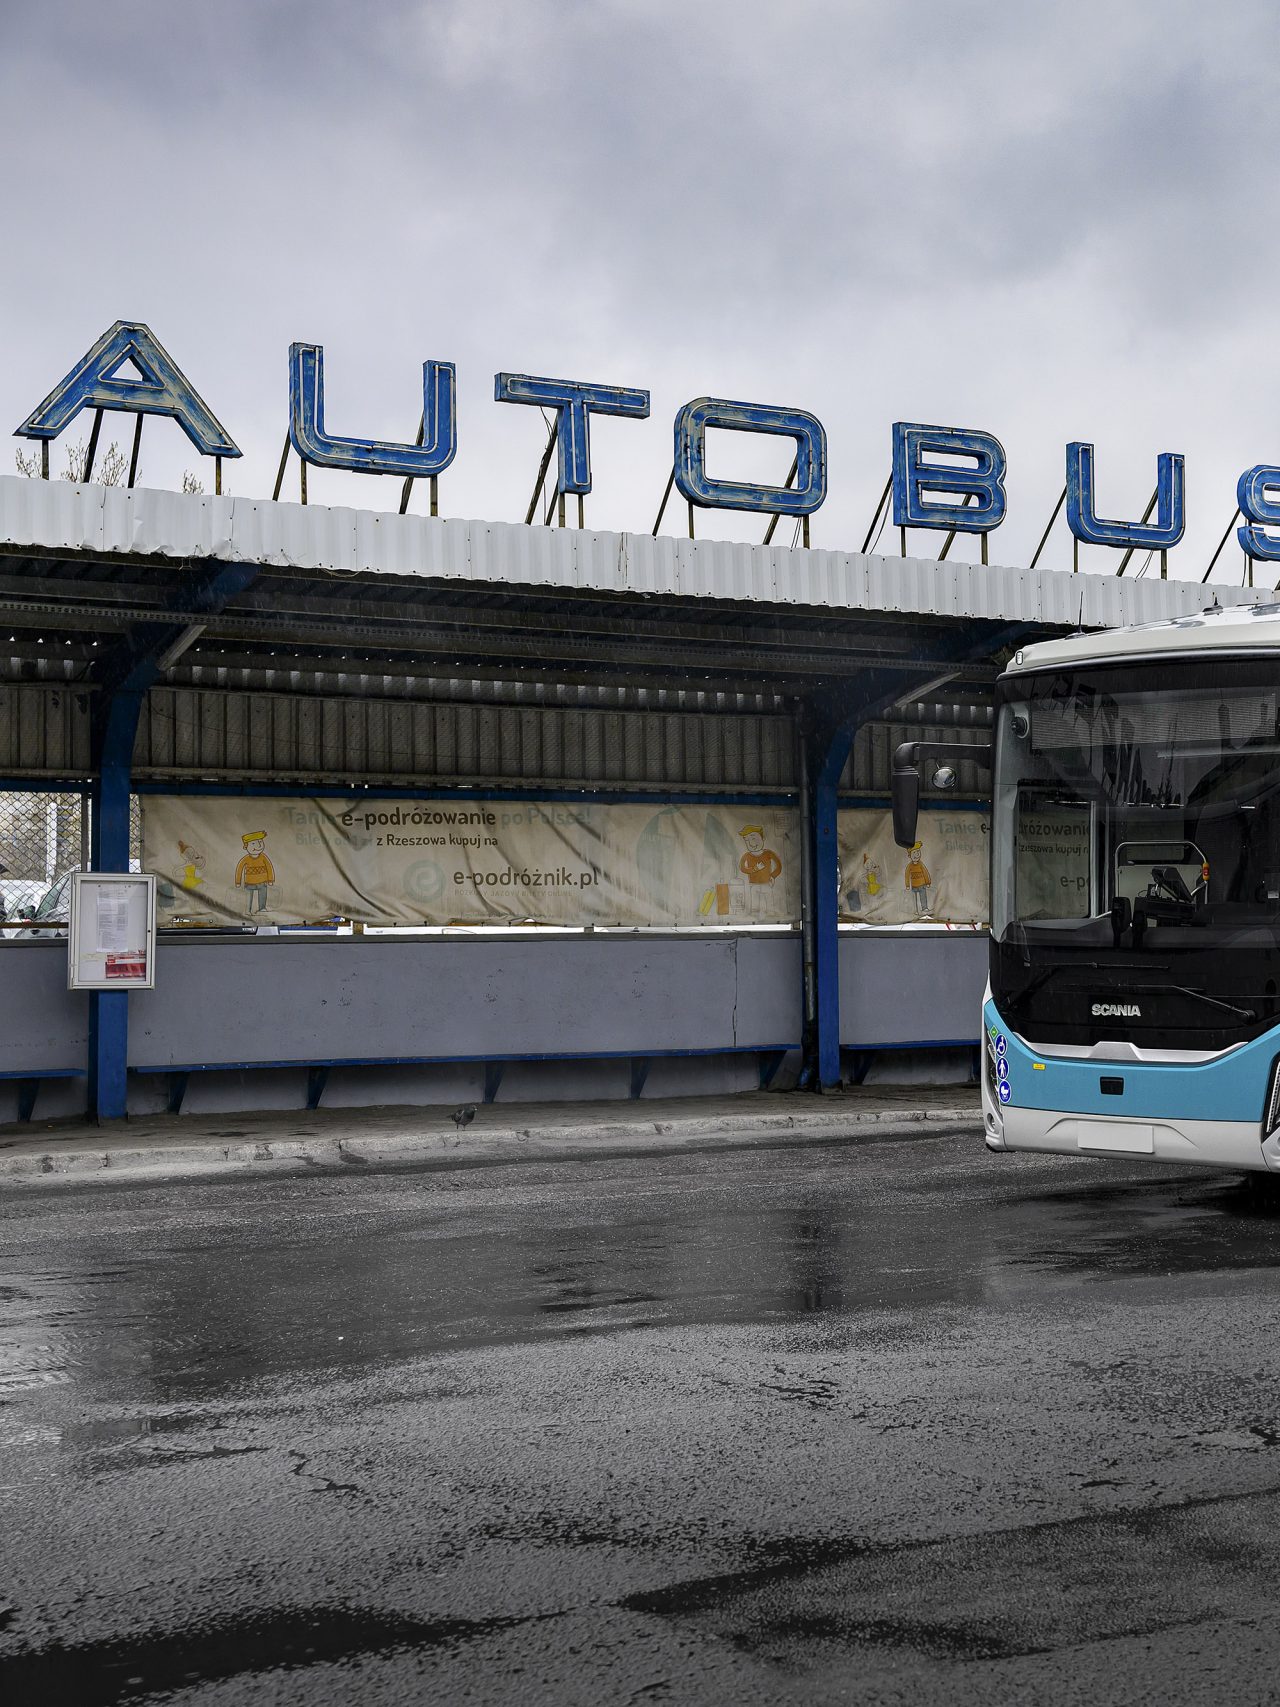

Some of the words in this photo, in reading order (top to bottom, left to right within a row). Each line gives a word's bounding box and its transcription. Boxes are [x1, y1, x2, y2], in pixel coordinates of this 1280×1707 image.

[341, 806, 497, 830] e-podróżowanie
[376, 837, 383, 846] z
[387, 834, 446, 847] Rzeszowa
[449, 833, 481, 849] kupuj
[484, 836, 498, 847] na
[452, 866, 599, 890] e-podróżnik.pl
[1091, 1003, 1142, 1017] SCANIA
